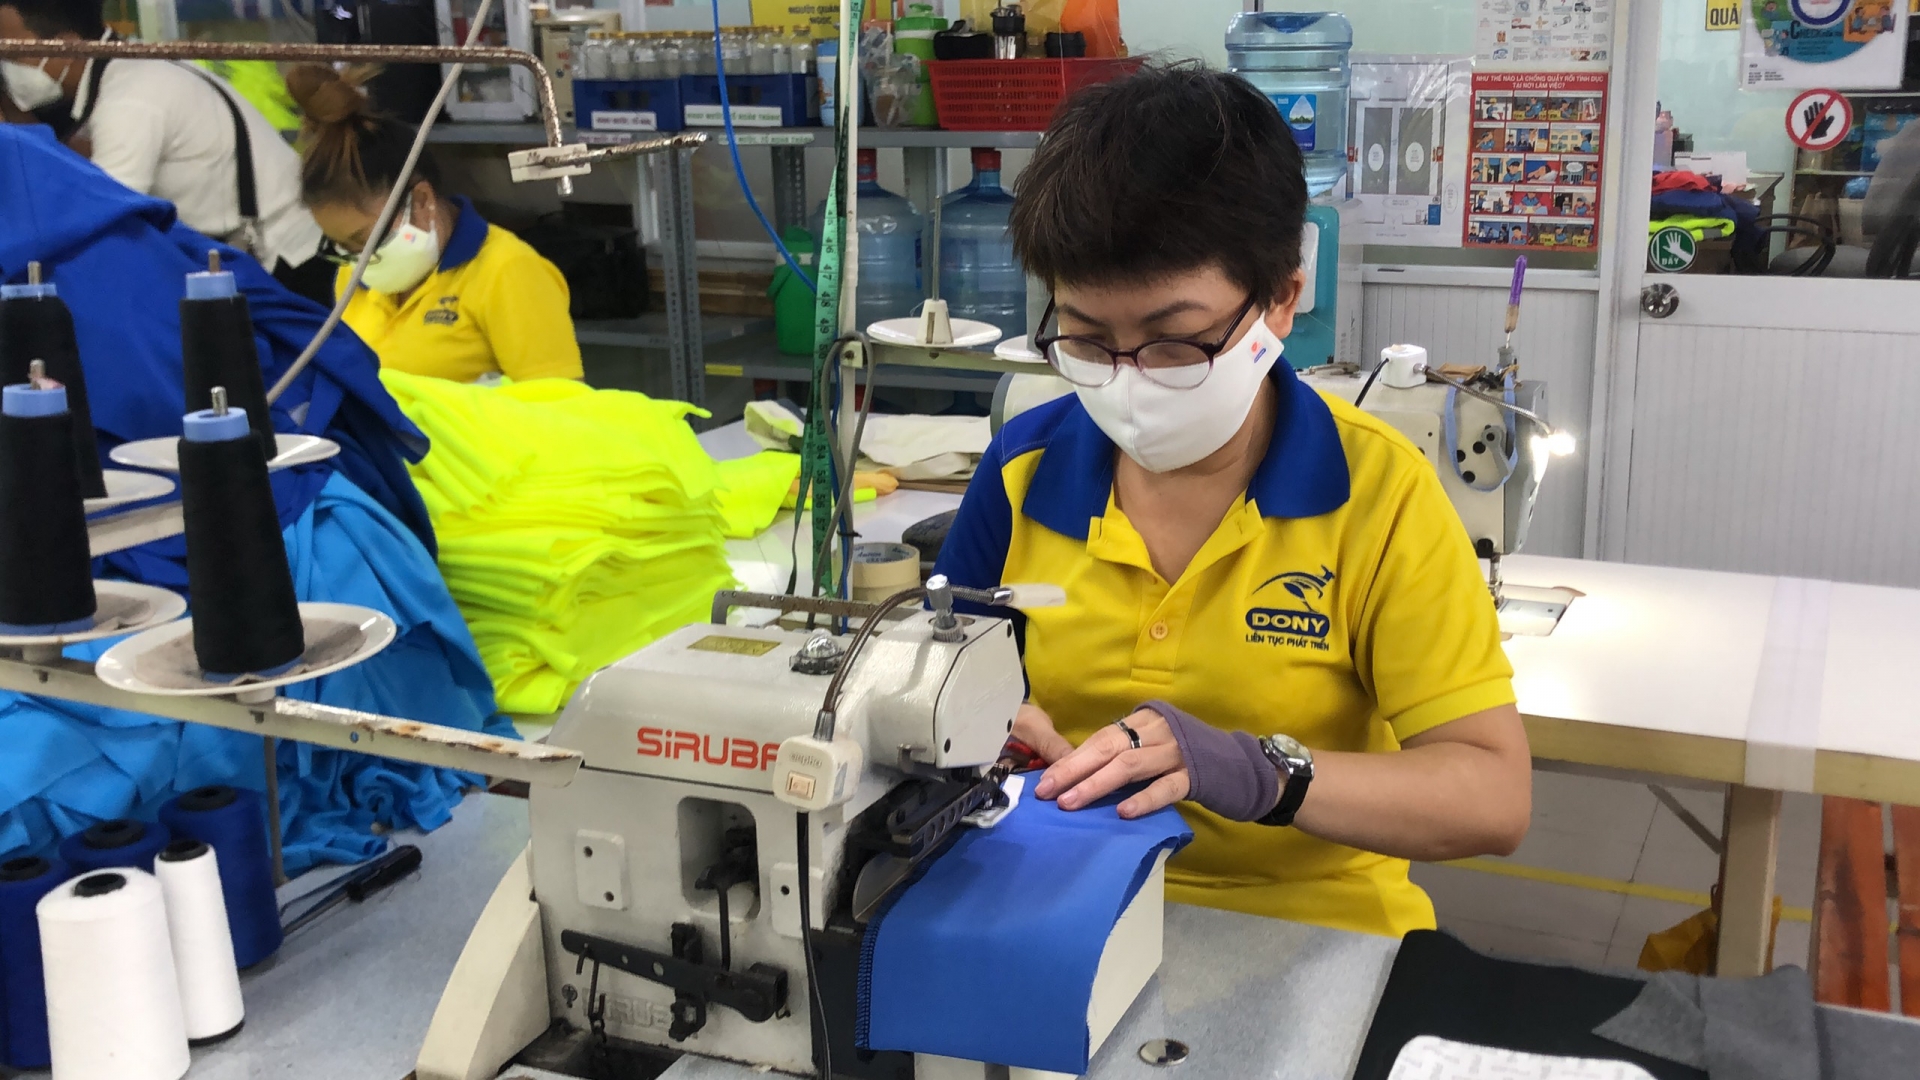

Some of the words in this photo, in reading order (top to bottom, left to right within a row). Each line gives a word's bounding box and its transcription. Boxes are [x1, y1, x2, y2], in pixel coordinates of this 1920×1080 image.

[1251, 612, 1326, 634] DONY
[1245, 632, 1265, 643] LIÊN
[1267, 634, 1285, 647] TỤC
[1286, 636, 1308, 648] PHÁT
